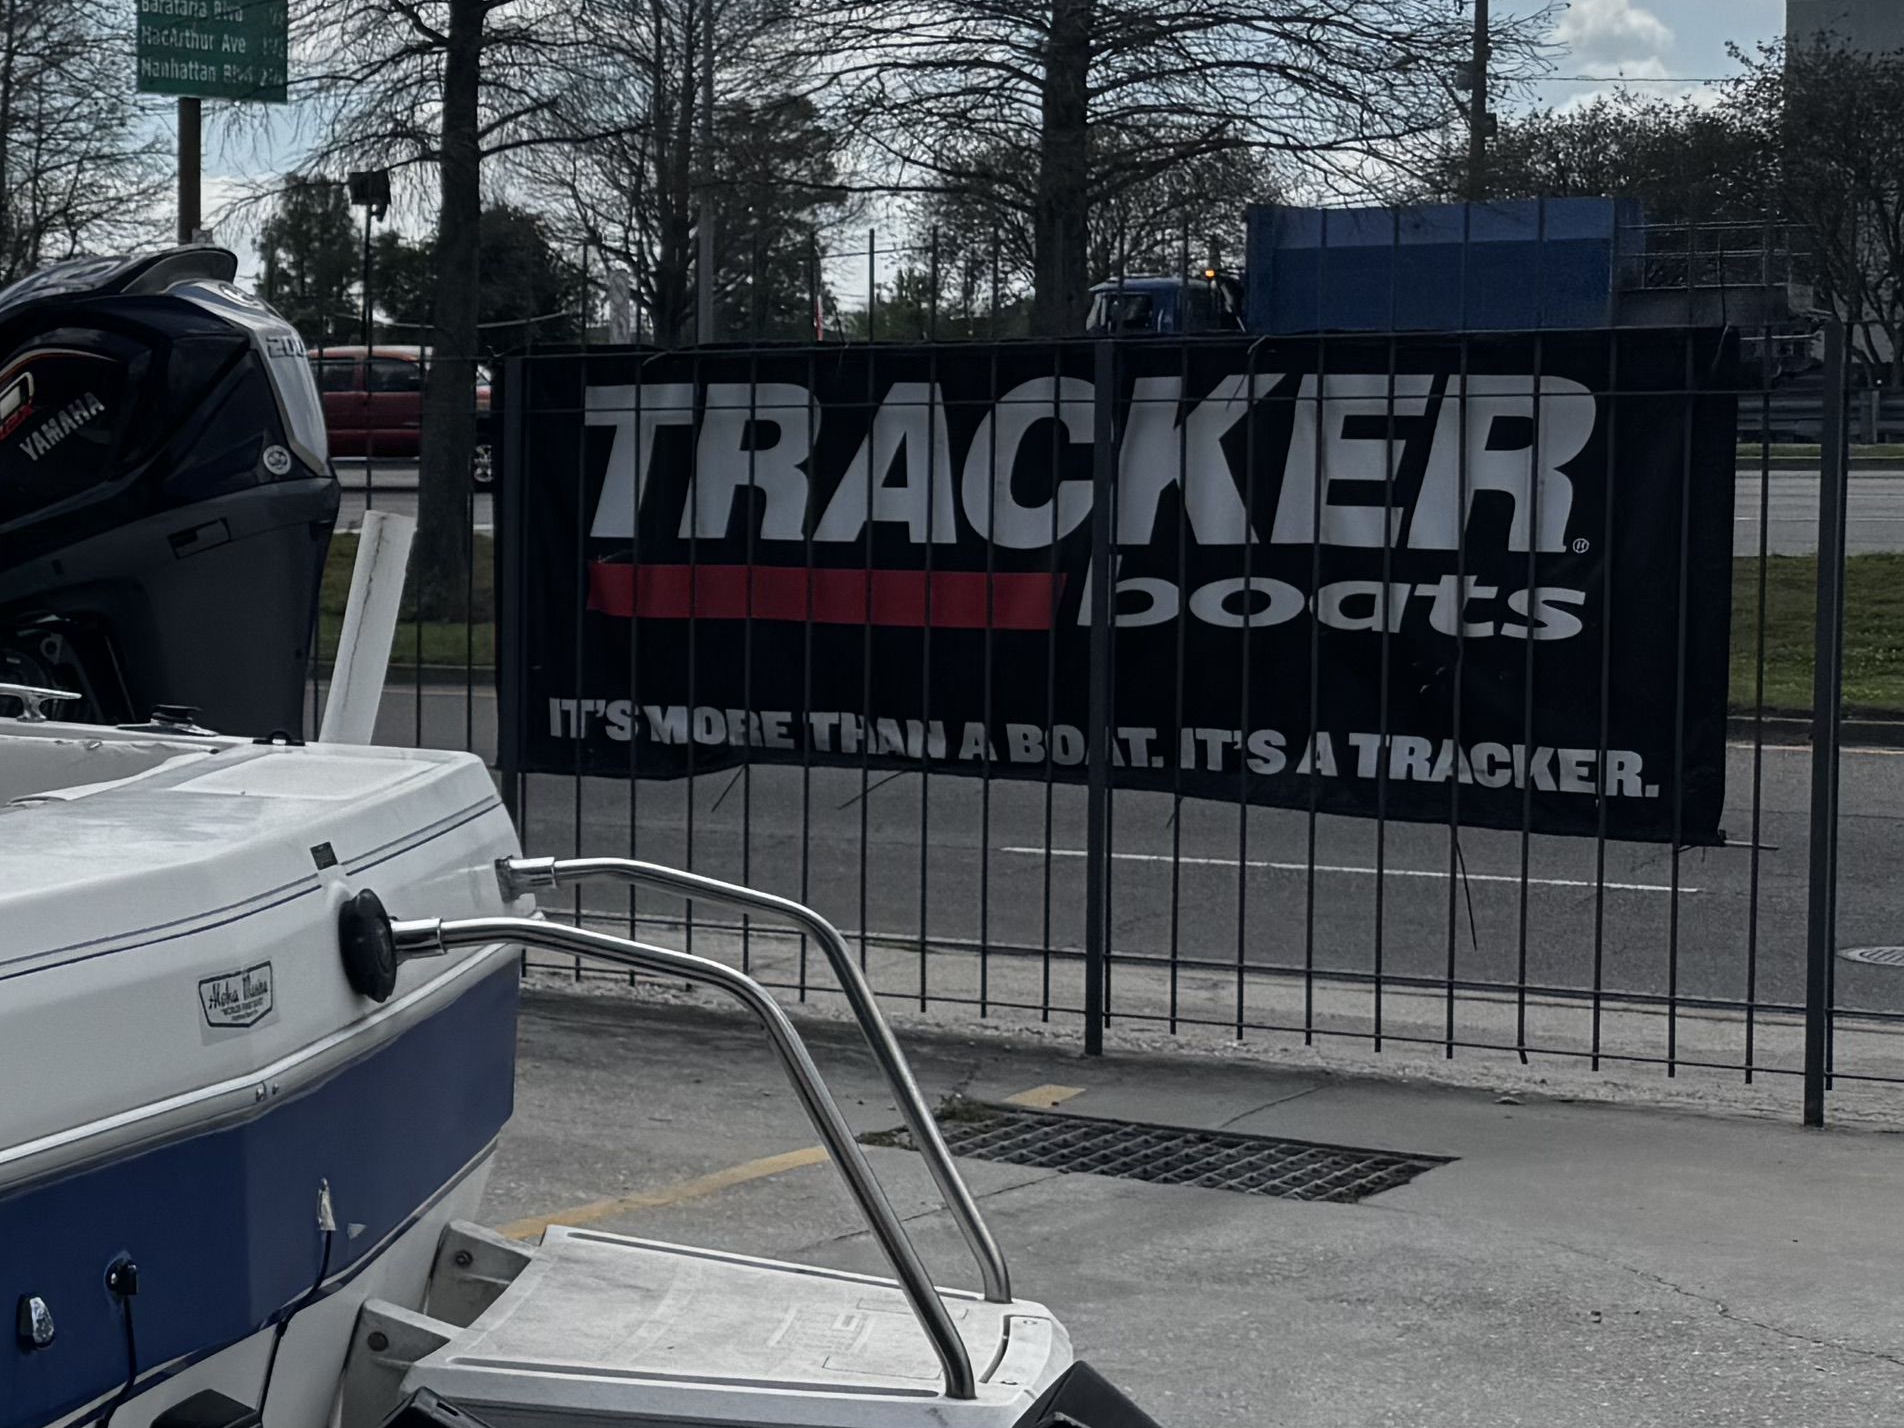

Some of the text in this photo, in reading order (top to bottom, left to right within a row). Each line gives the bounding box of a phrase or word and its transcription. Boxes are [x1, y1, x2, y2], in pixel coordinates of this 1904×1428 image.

[141, 25, 214, 51] MacArthur
[221, 34, 246, 54] Ave
[141, 57, 217, 83] Manhattan
[18, 391, 106, 462] YAMAHA
[584, 372, 1597, 553] TRACKER
[1076, 553, 1587, 641] boats
[549, 697, 640, 742] IT'S
[643, 704, 794, 749] MORE
[802, 710, 948, 760] THAN
[959, 721, 999, 763] A
[1179, 726, 1289, 775] IT'S
[1295, 731, 1339, 778] A
[1348, 731, 1661, 799] TRACKER.
